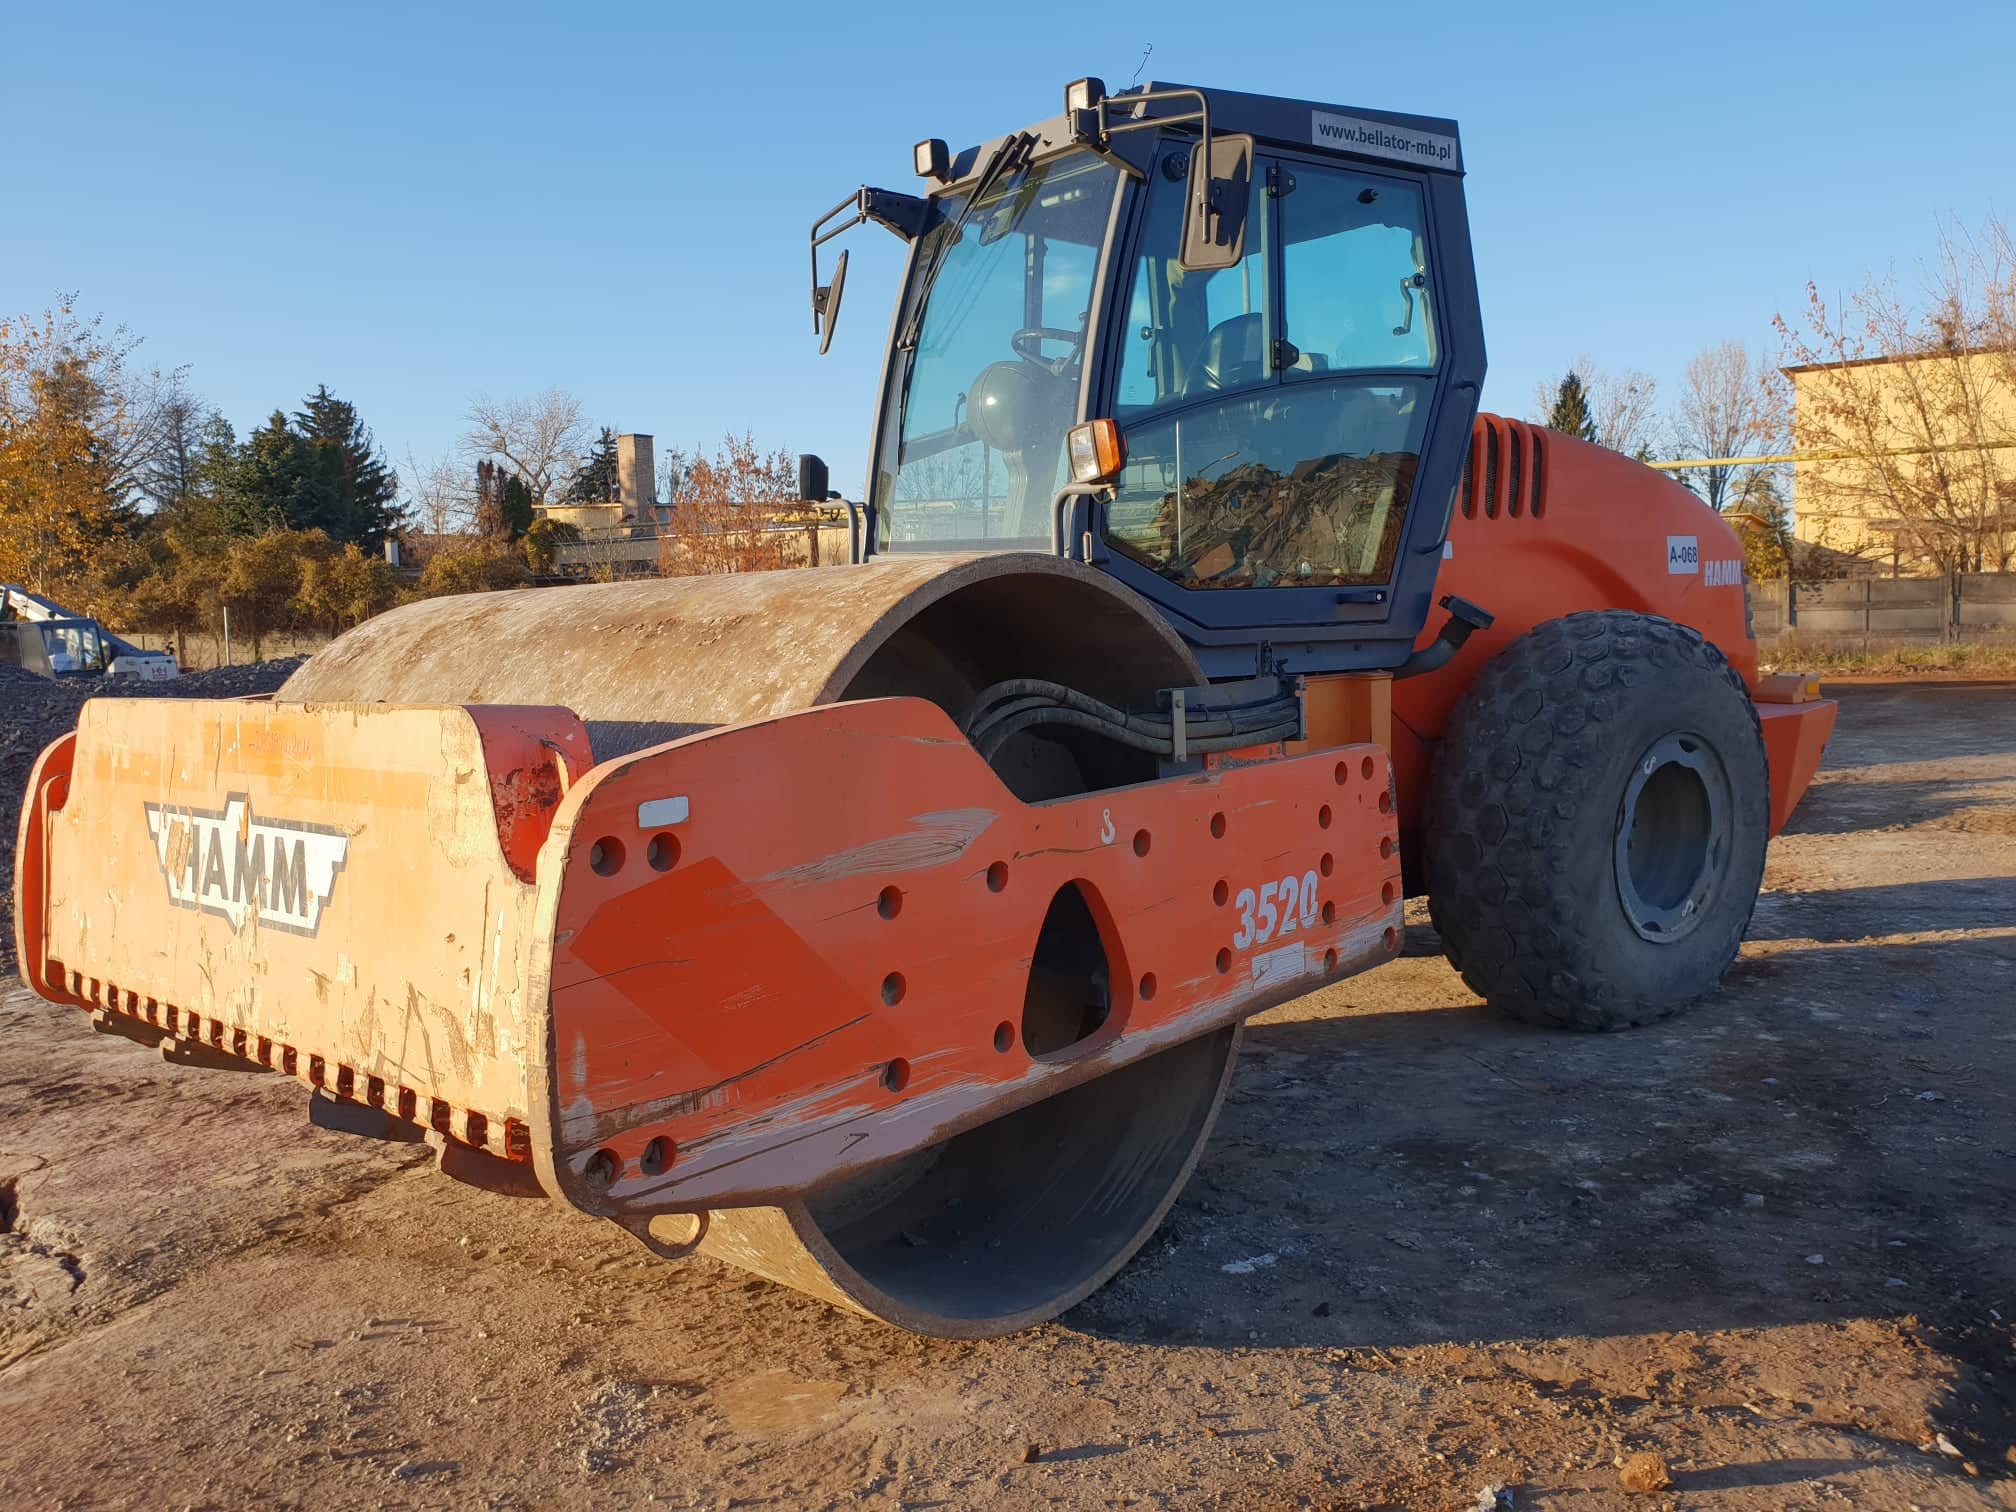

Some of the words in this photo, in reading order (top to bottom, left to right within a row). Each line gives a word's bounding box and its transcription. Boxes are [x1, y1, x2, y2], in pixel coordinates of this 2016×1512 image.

[1319, 123, 1451, 160] www.bellator-mb.pl
[1669, 546, 1698, 563] A-068
[1704, 559, 1741, 586] HAMM
[1233, 869, 1319, 951] 3520
